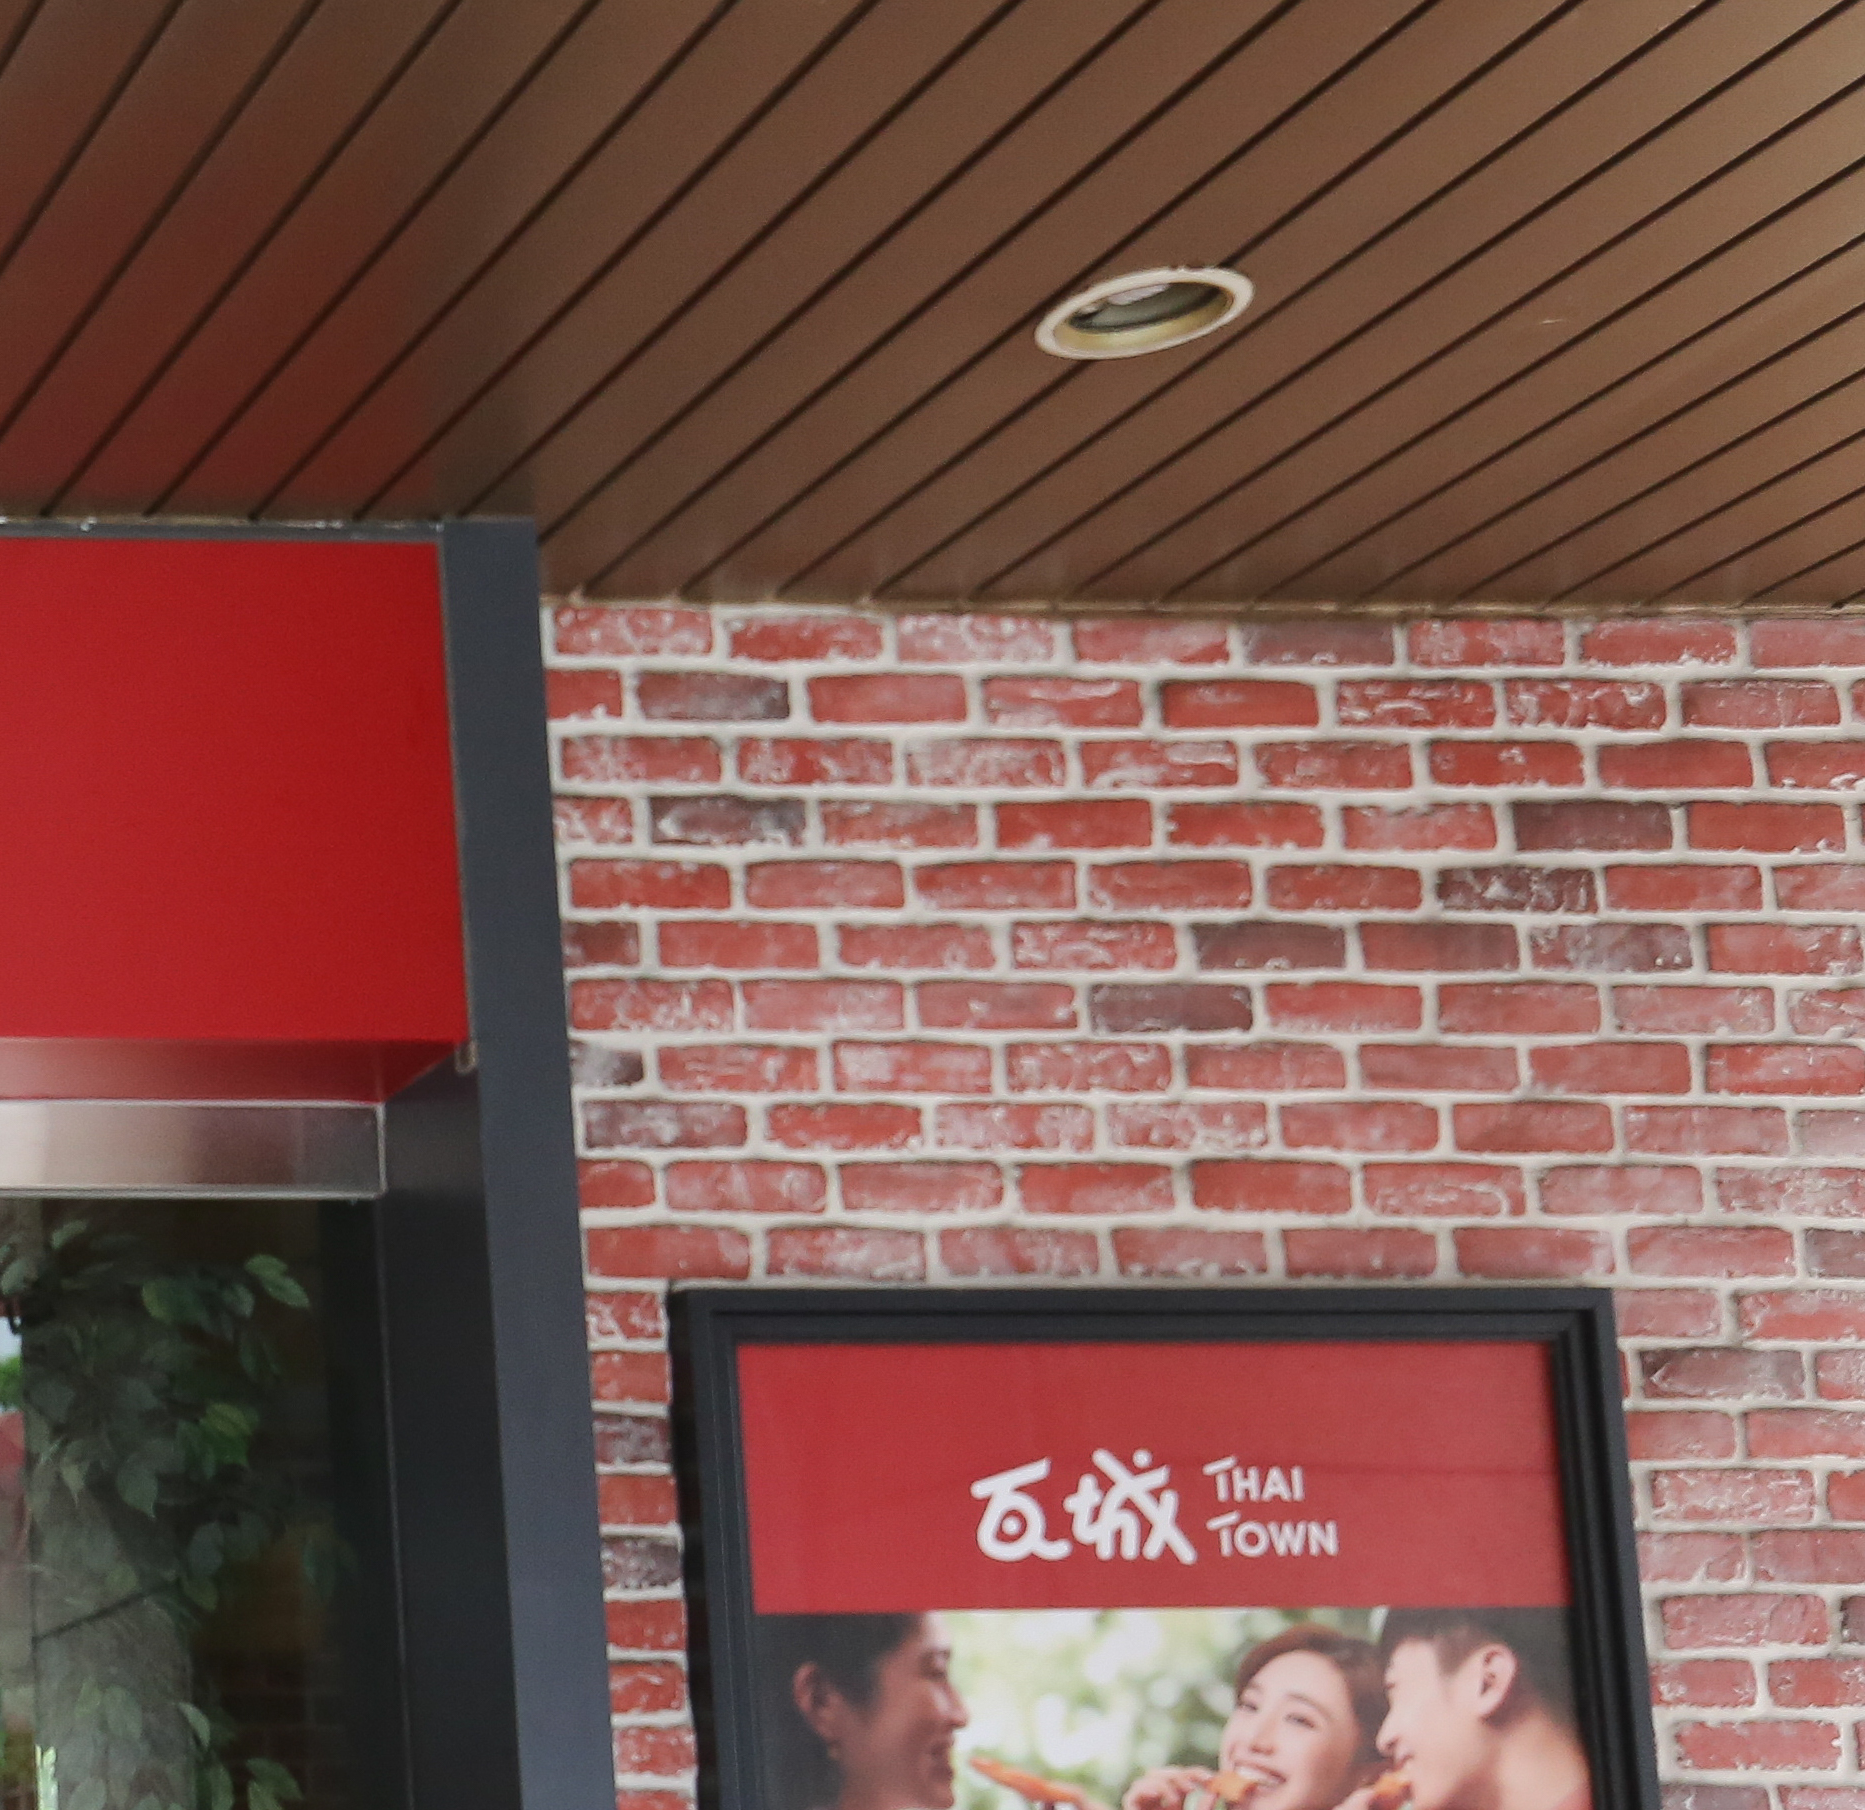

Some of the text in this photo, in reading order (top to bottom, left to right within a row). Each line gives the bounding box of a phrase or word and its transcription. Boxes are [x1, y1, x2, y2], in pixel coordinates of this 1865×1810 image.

[1203, 1455, 1306, 1503] THAI
[969, 1447, 1199, 1566] 瓦城
[1205, 1510, 1339, 1557] TOWN
